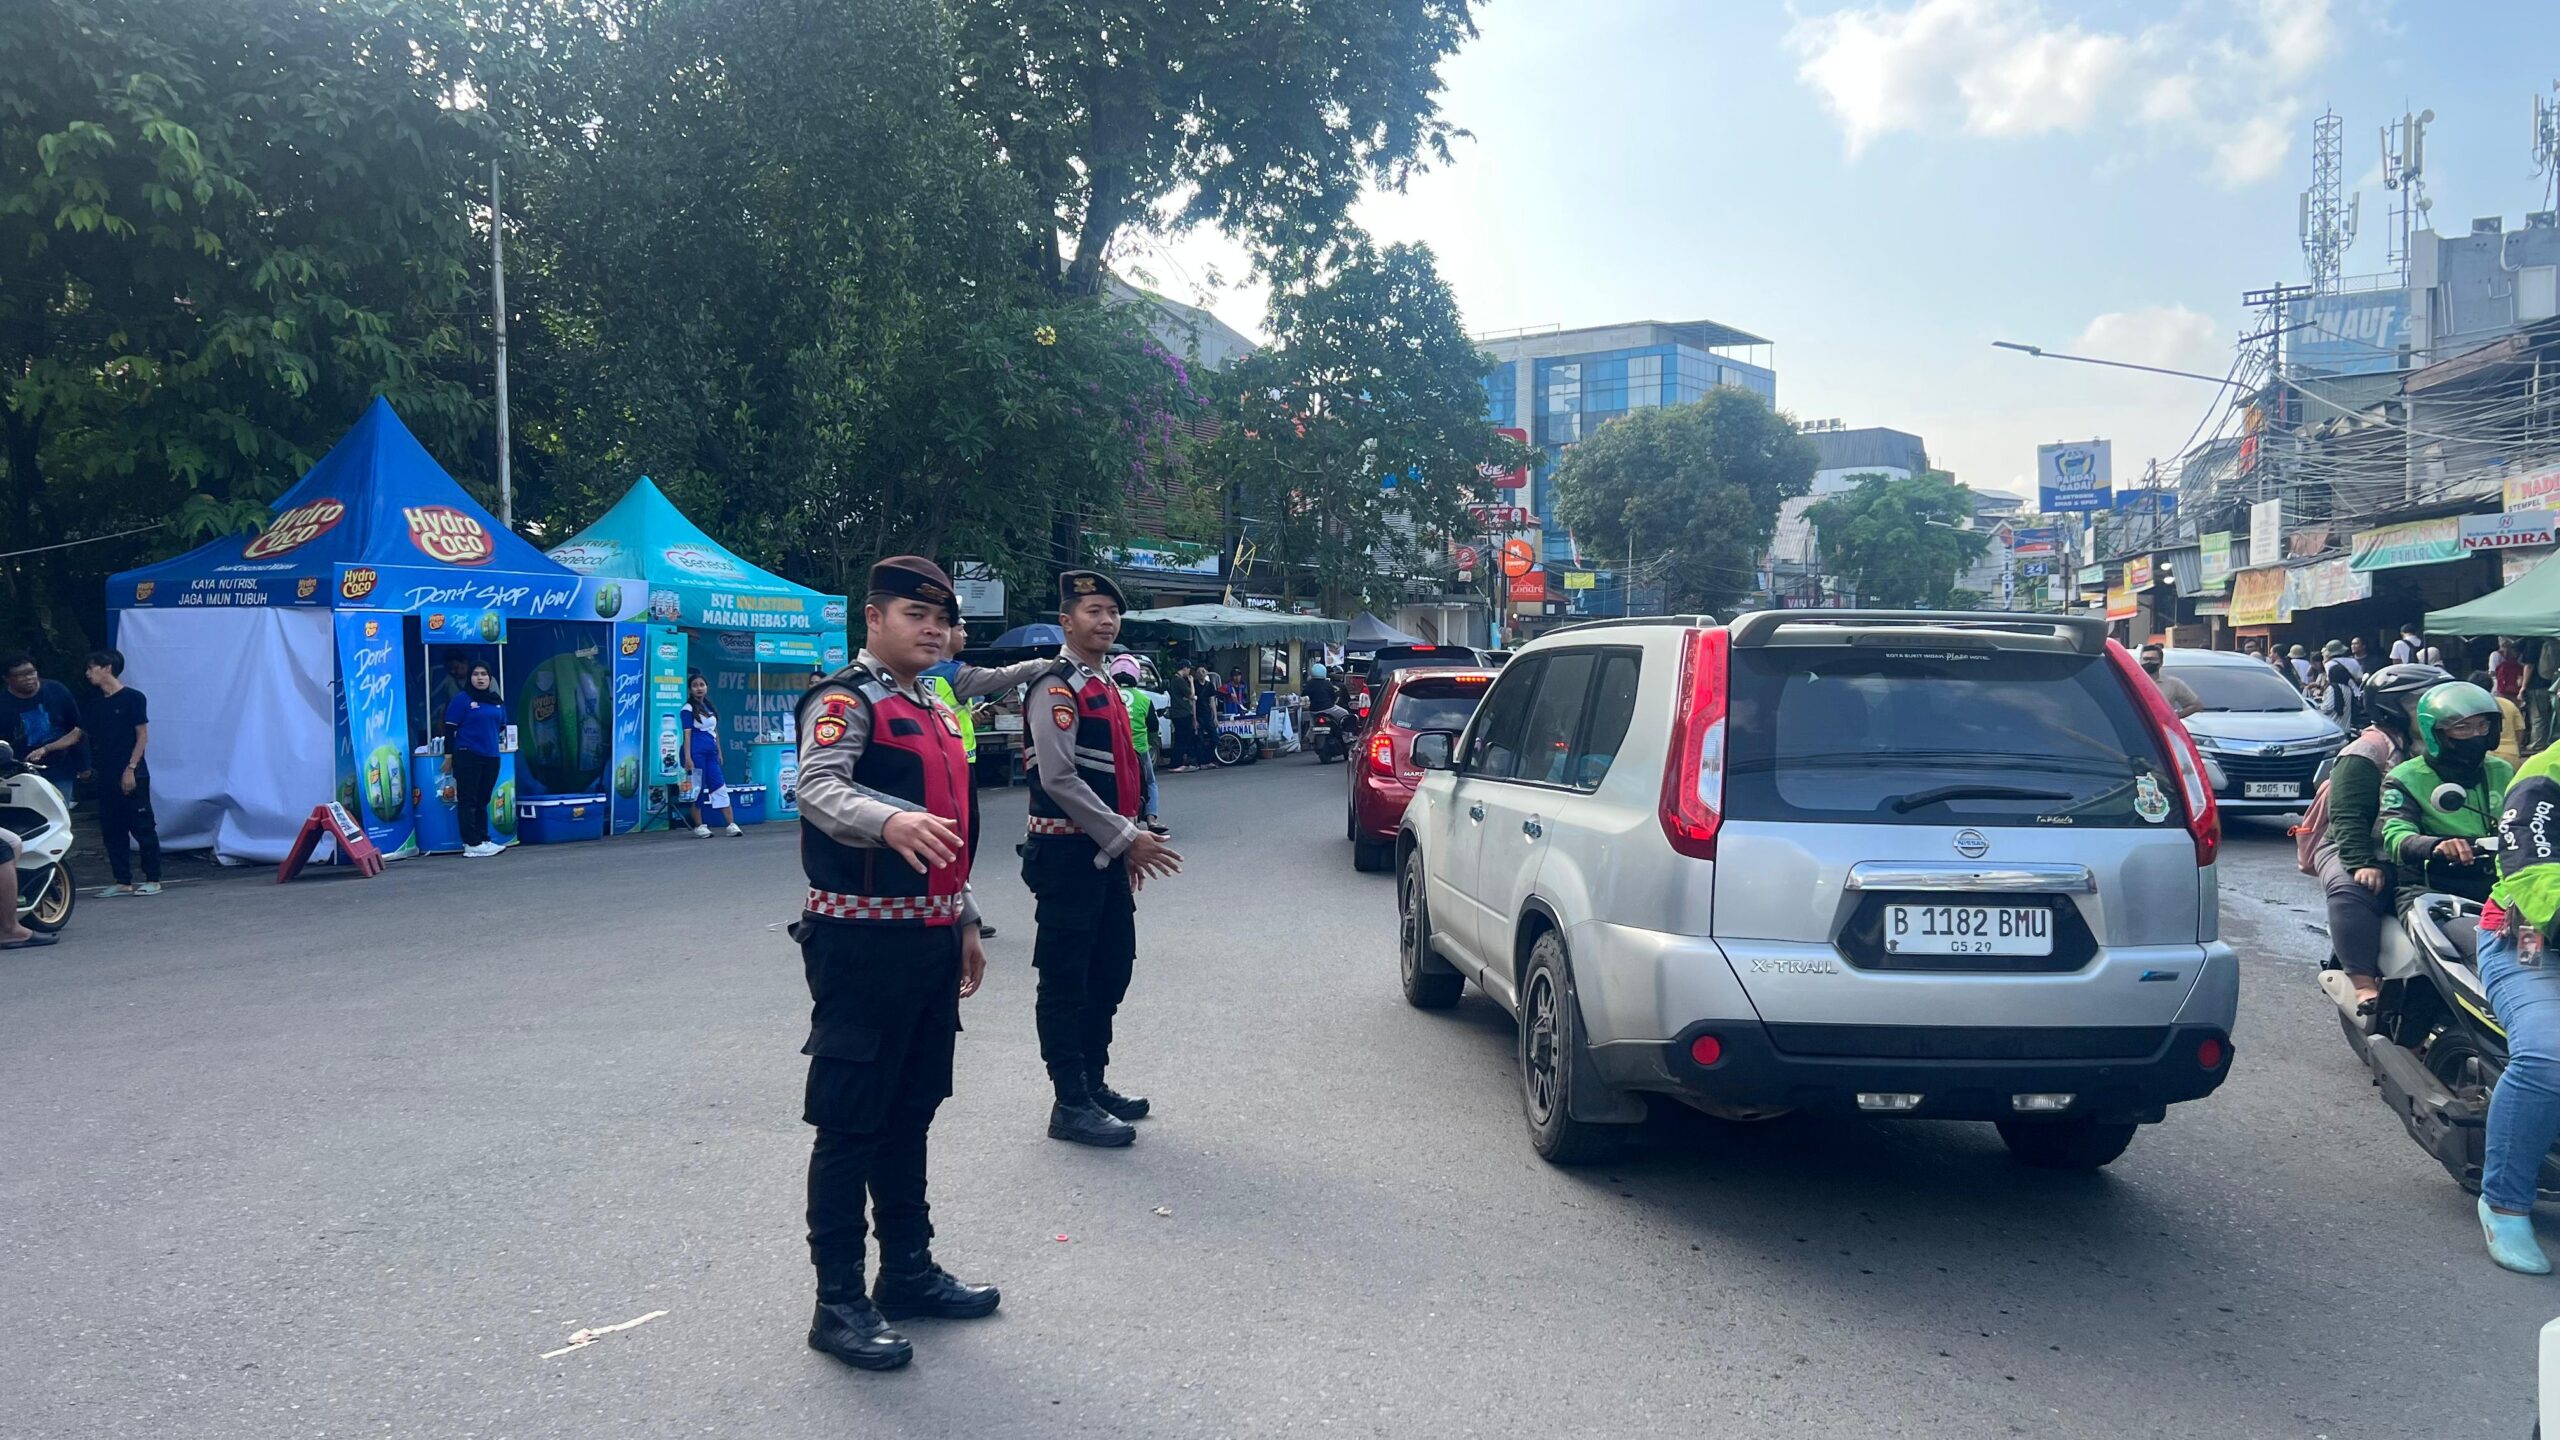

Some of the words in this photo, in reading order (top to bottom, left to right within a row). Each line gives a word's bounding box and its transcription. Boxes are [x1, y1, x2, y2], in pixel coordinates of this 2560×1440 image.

[2301, 299, 2396, 348] KNAUF
[2056, 473, 2094, 485] PANDAI
[2060, 481, 2092, 491] GADAI
[2508, 499, 2542, 512] STEMPEL
[269, 503, 344, 531] Hydro
[403, 507, 484, 537] Hydro
[245, 523, 320, 558] Coco
[421, 531, 486, 561] Coco
[2463, 532, 2552, 548] NADIRA
[679, 555, 736, 572] Benecol
[2026, 565, 2043, 573] 24
[192, 579, 216, 589] KAYA
[344, 569, 377, 583] Hydro
[179, 592, 203, 605] JAGA
[206, 592, 231, 605] IMUN
[234, 592, 267, 605] TUBUH
[343, 580, 372, 599] Coco
[476, 585, 529, 610] Stop
[530, 577, 582, 618] Now!
[711, 593, 734, 608] BYE
[703, 609, 748, 625] MAKAN
[750, 613, 788, 627] BEBAS
[790, 615, 811, 628] POL
[717, 671, 746, 690] BYE
[360, 673, 392, 711] Stop
[617, 693, 641, 716] Stop
[2245, 784, 2252, 792] B
[2282, 784, 2299, 793] TYU
[1894, 907, 1909, 935] B
[1921, 907, 1988, 937] 1182
[1998, 908, 2047, 938] BMU
[1750, 959, 1839, 973] X-TRAIL
